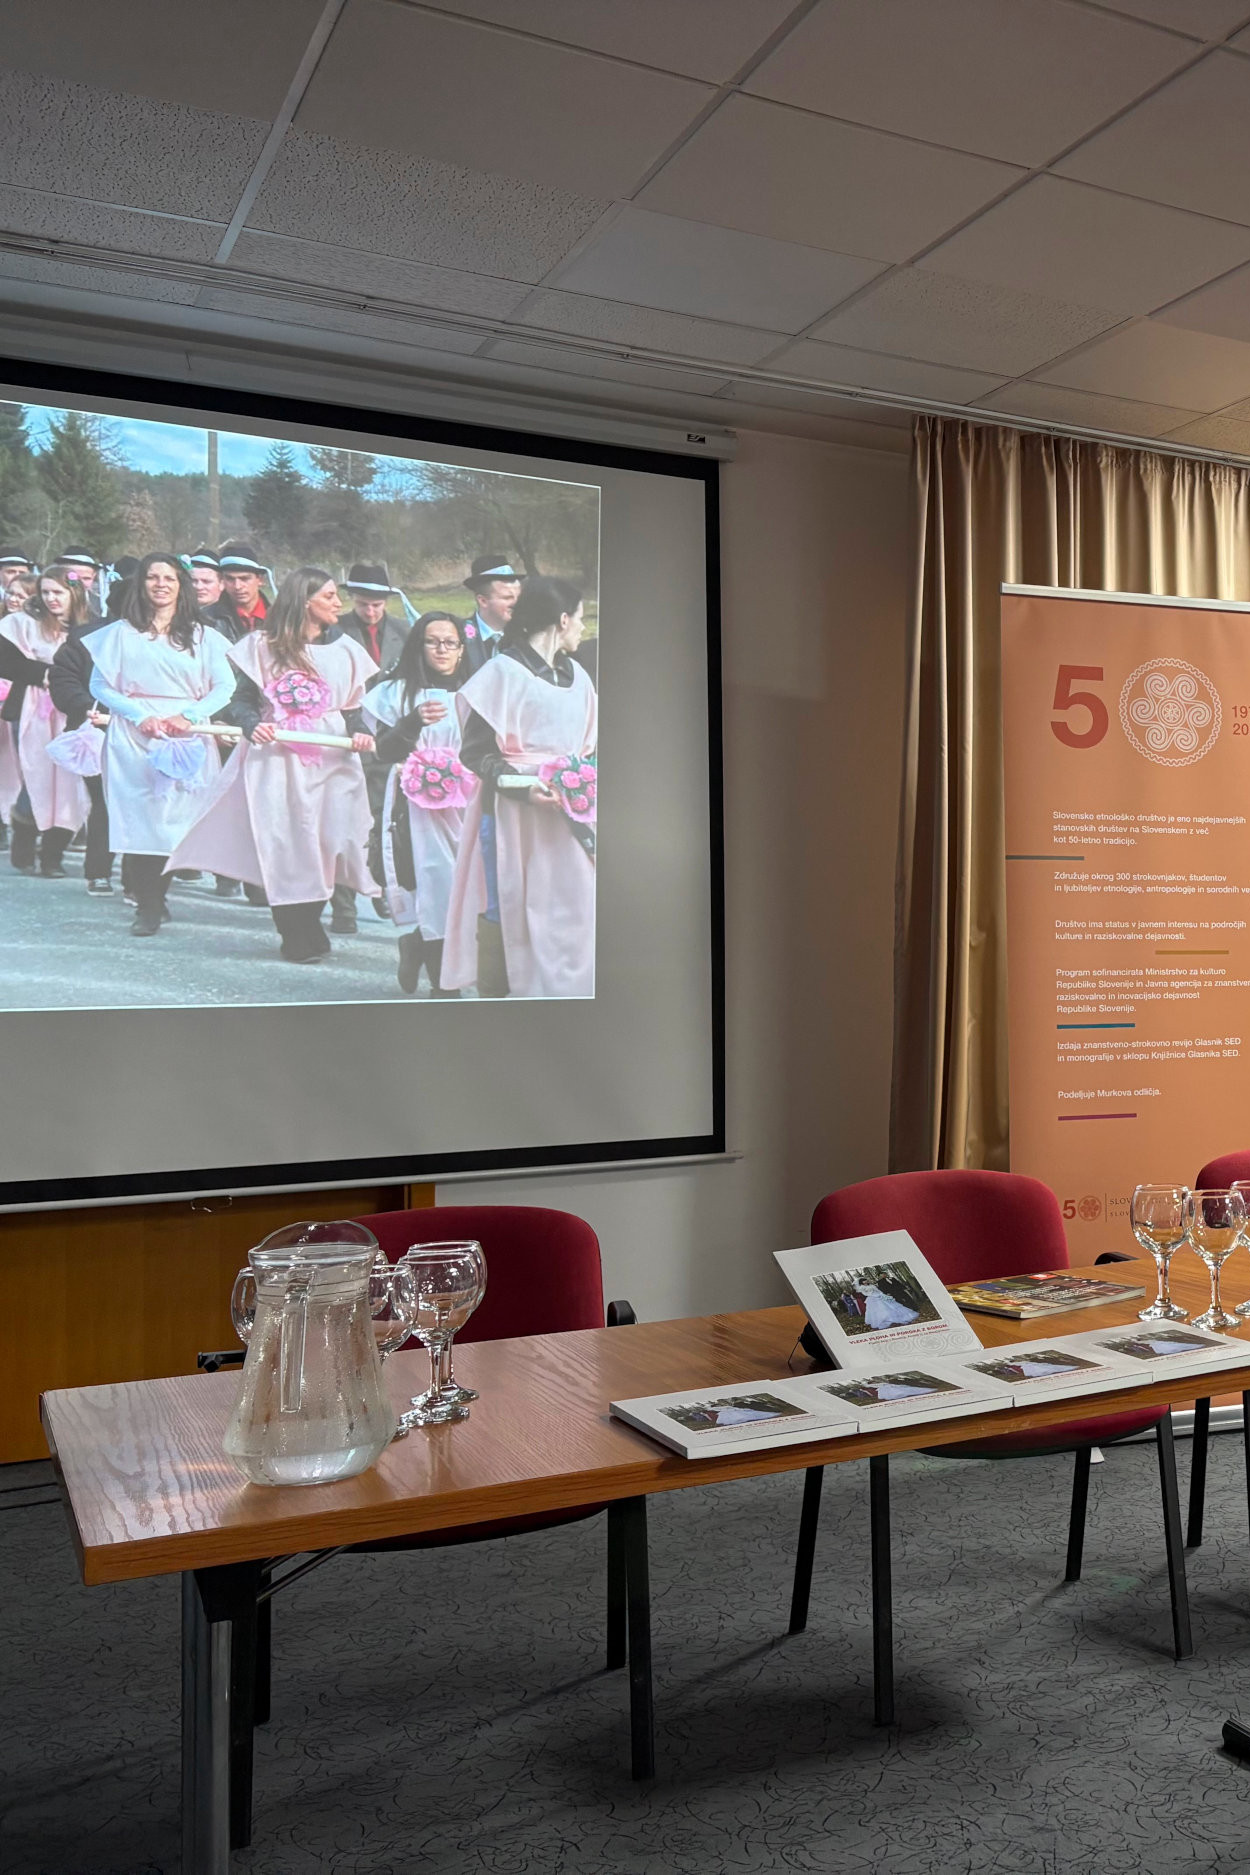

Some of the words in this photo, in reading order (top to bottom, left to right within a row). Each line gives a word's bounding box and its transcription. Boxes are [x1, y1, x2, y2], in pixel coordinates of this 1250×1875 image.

[1053, 812, 1094, 820] Slovensko
[1096, 813, 1135, 821] etnološko
[1137, 814, 1166, 822] društvo
[1167, 815, 1175, 823] je
[1193, 816, 1246, 825] najdejavnejših
[1053, 824, 1096, 832] stanovskih
[1098, 825, 1127, 833] društev
[1141, 826, 1187, 834] Slovenskem
[1196, 827, 1209, 835] več
[1054, 836, 1066, 844] kot
[1068, 836, 1101, 844] 50-letno
[1103, 837, 1137, 846] tradicijo.
[1055, 872, 1089, 881] Združuje
[1091, 873, 1114, 882] okrog
[1133, 873, 1187, 882] strokovnjakov,
[1189, 874, 1226, 882] študentov
[1055, 884, 1062, 892] in
[1064, 884, 1102, 893] ljubiteljev
[1103, 885, 1144, 893] etnologije,
[1146, 885, 1195, 894] antropologije
[1055, 920, 1087, 928] Društvo
[1138, 921, 1165, 929] javnem
[1211, 921, 1246, 930] področjih
[1055, 932, 1083, 940] kulture
[1085, 932, 1092, 940] in
[1094, 932, 1143, 940] raziskovalne
[1145, 932, 1186, 941] dejavnosti.
[1056, 969, 1090, 978] Program
[1093, 968, 1143, 976] sofinancirata
[1056, 980, 1096, 990] Republike
[1098, 980, 1134, 989] Slovenije
[1170, 980, 1202, 989] agencija
[1056, 993, 1106, 1001] raziskovalno
[1118, 992, 1161, 1000] inovacijsko
[1163, 992, 1200, 1000] dejavnost
[1057, 1005, 1096, 1014] Republike
[1057, 1042, 1081, 1051] Izdaja
[1172, 1039, 1192, 1048] revijo
[1195, 1037, 1222, 1045] Glasnik
[1225, 1037, 1241, 1045] SED
[1057, 1054, 1065, 1062] in
[1067, 1053, 1114, 1062] monografije
[1123, 1052, 1149, 1061] sklopu
[1151, 1051, 1186, 1060] Knjižnice
[1058, 1091, 1095, 1100] Podeljuje
